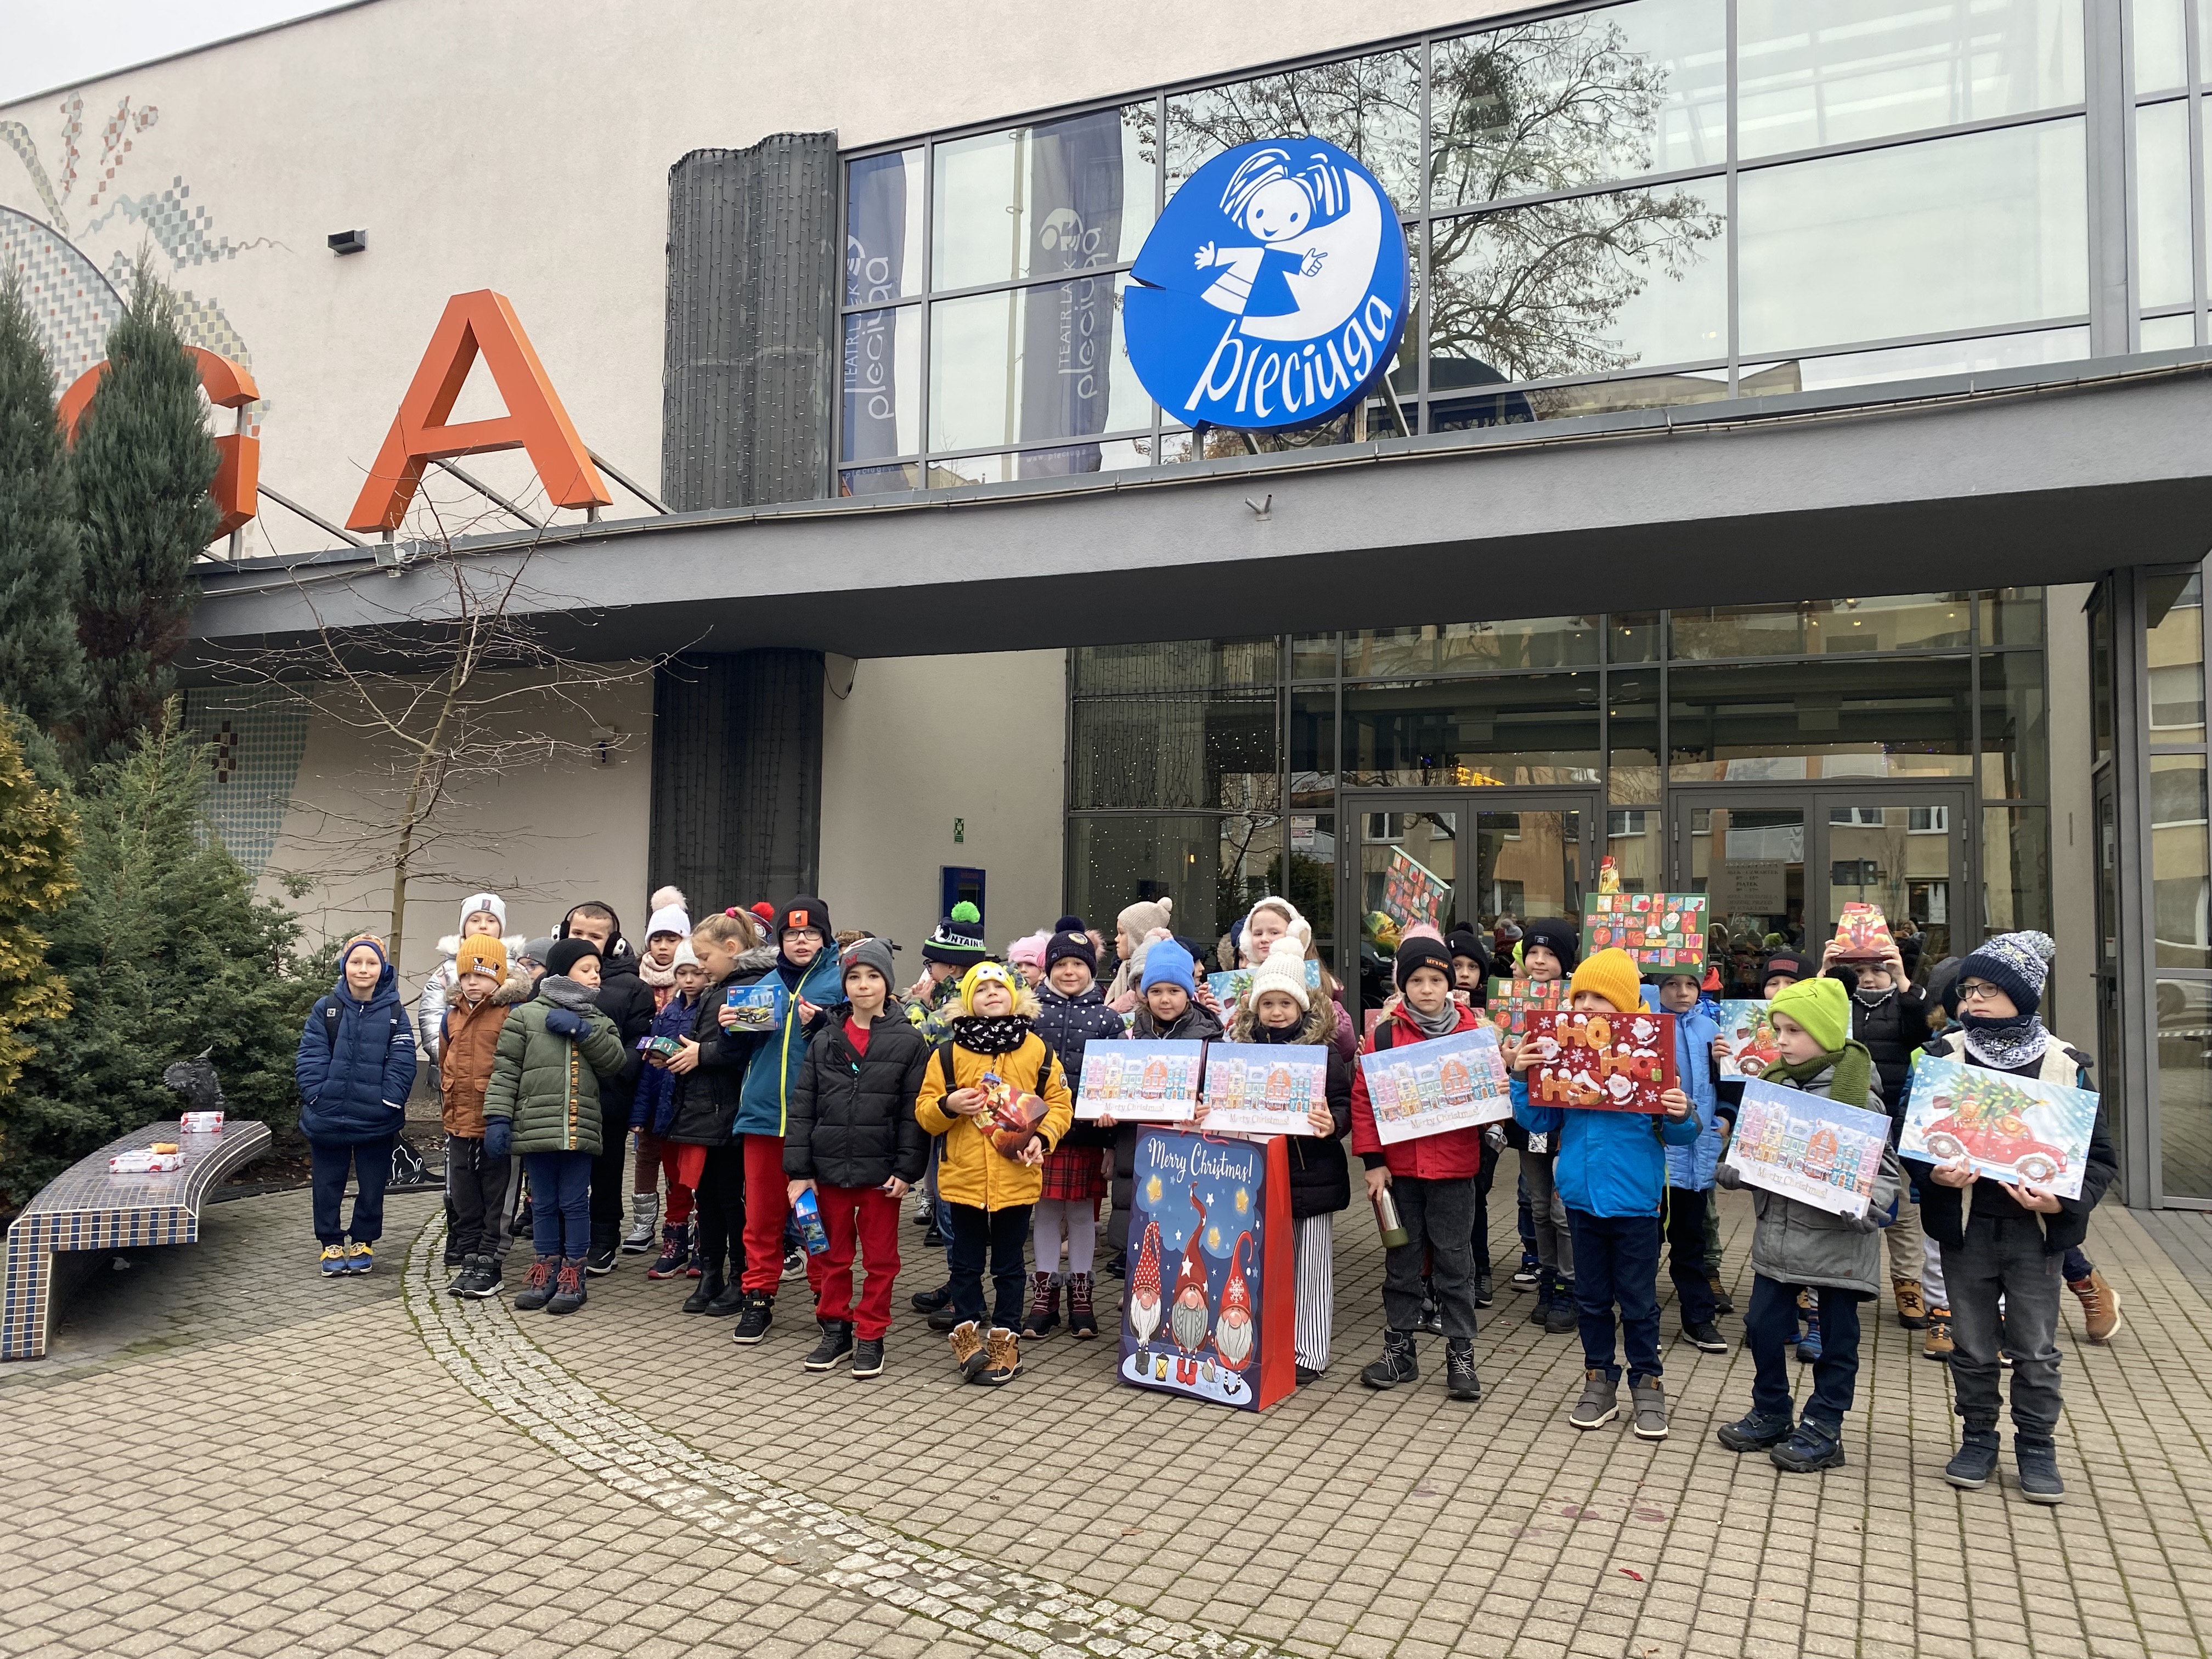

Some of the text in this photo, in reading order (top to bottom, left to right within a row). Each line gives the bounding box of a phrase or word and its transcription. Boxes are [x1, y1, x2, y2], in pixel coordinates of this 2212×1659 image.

[1060, 259, 1076, 304] LAK
[1184, 294, 1392, 418] pleciuga
[1615, 896, 1625, 905] 21
[1600, 930, 1606, 941] 7
[1515, 981, 1524, 990] 21
[1499, 1014, 1507, 1025] 7
[1555, 1013, 1611, 1050] HO
[1598, 1042, 1661, 1080] HO
[1148, 1137, 1253, 1184] Merry Christmas!
